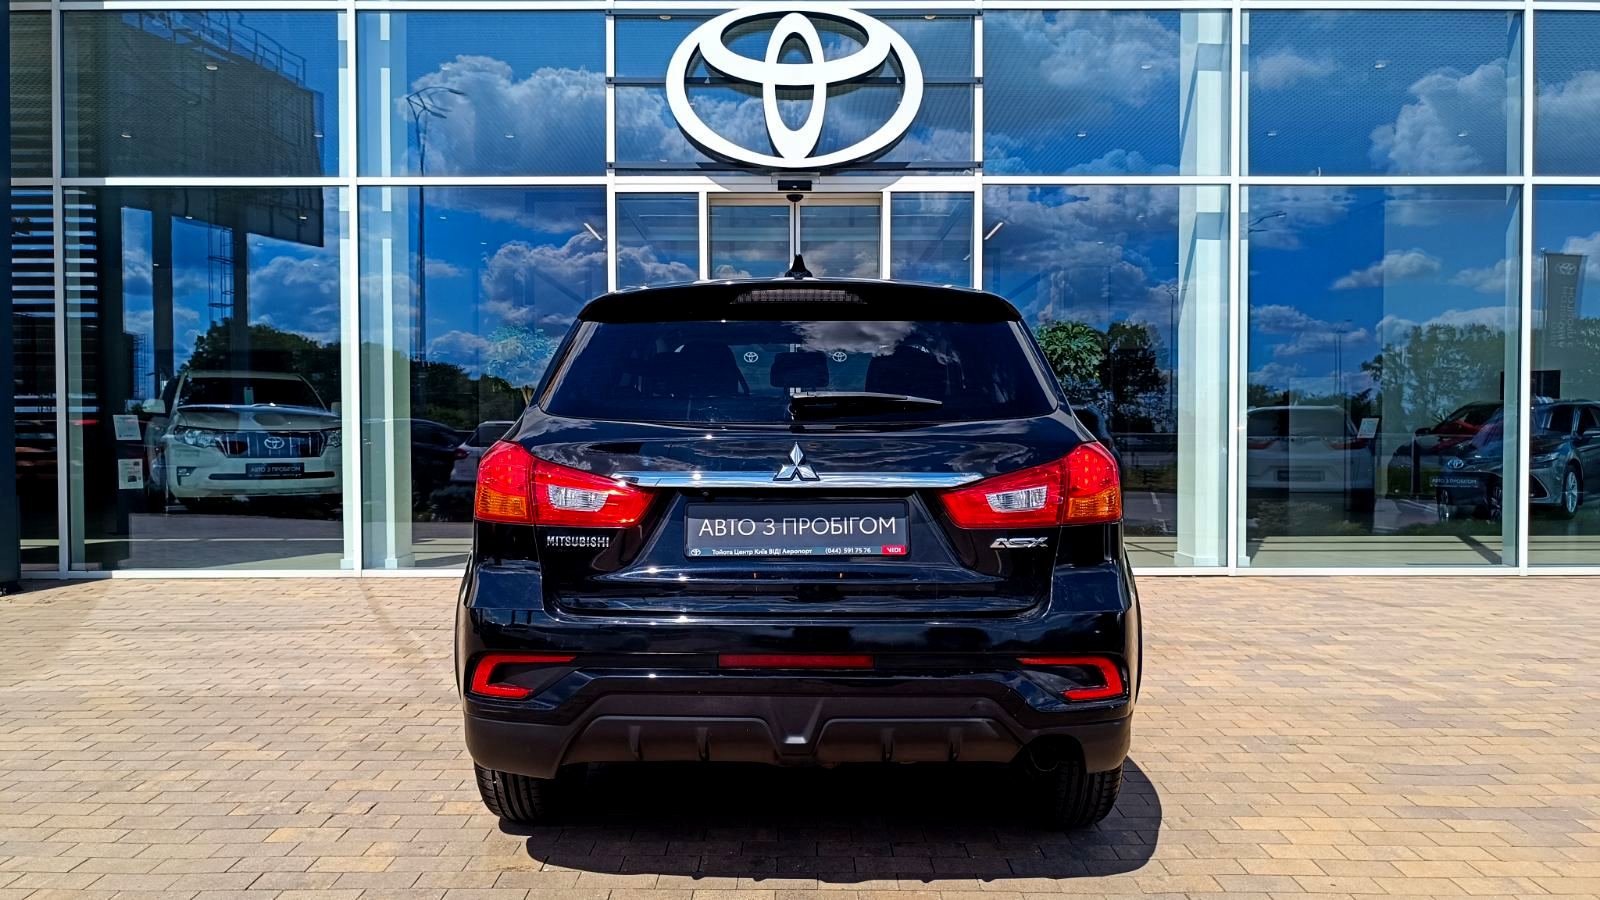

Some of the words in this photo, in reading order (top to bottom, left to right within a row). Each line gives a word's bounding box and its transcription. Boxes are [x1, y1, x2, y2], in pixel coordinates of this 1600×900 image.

[698, 518, 756, 537] АВТО
[762, 518, 775, 536] З
[782, 516, 896, 536] ПРОБІГОМ
[546, 535, 609, 548] MITSUBISHI
[990, 536, 1048, 548] ASX
[782, 547, 812, 557] Аеропорт
